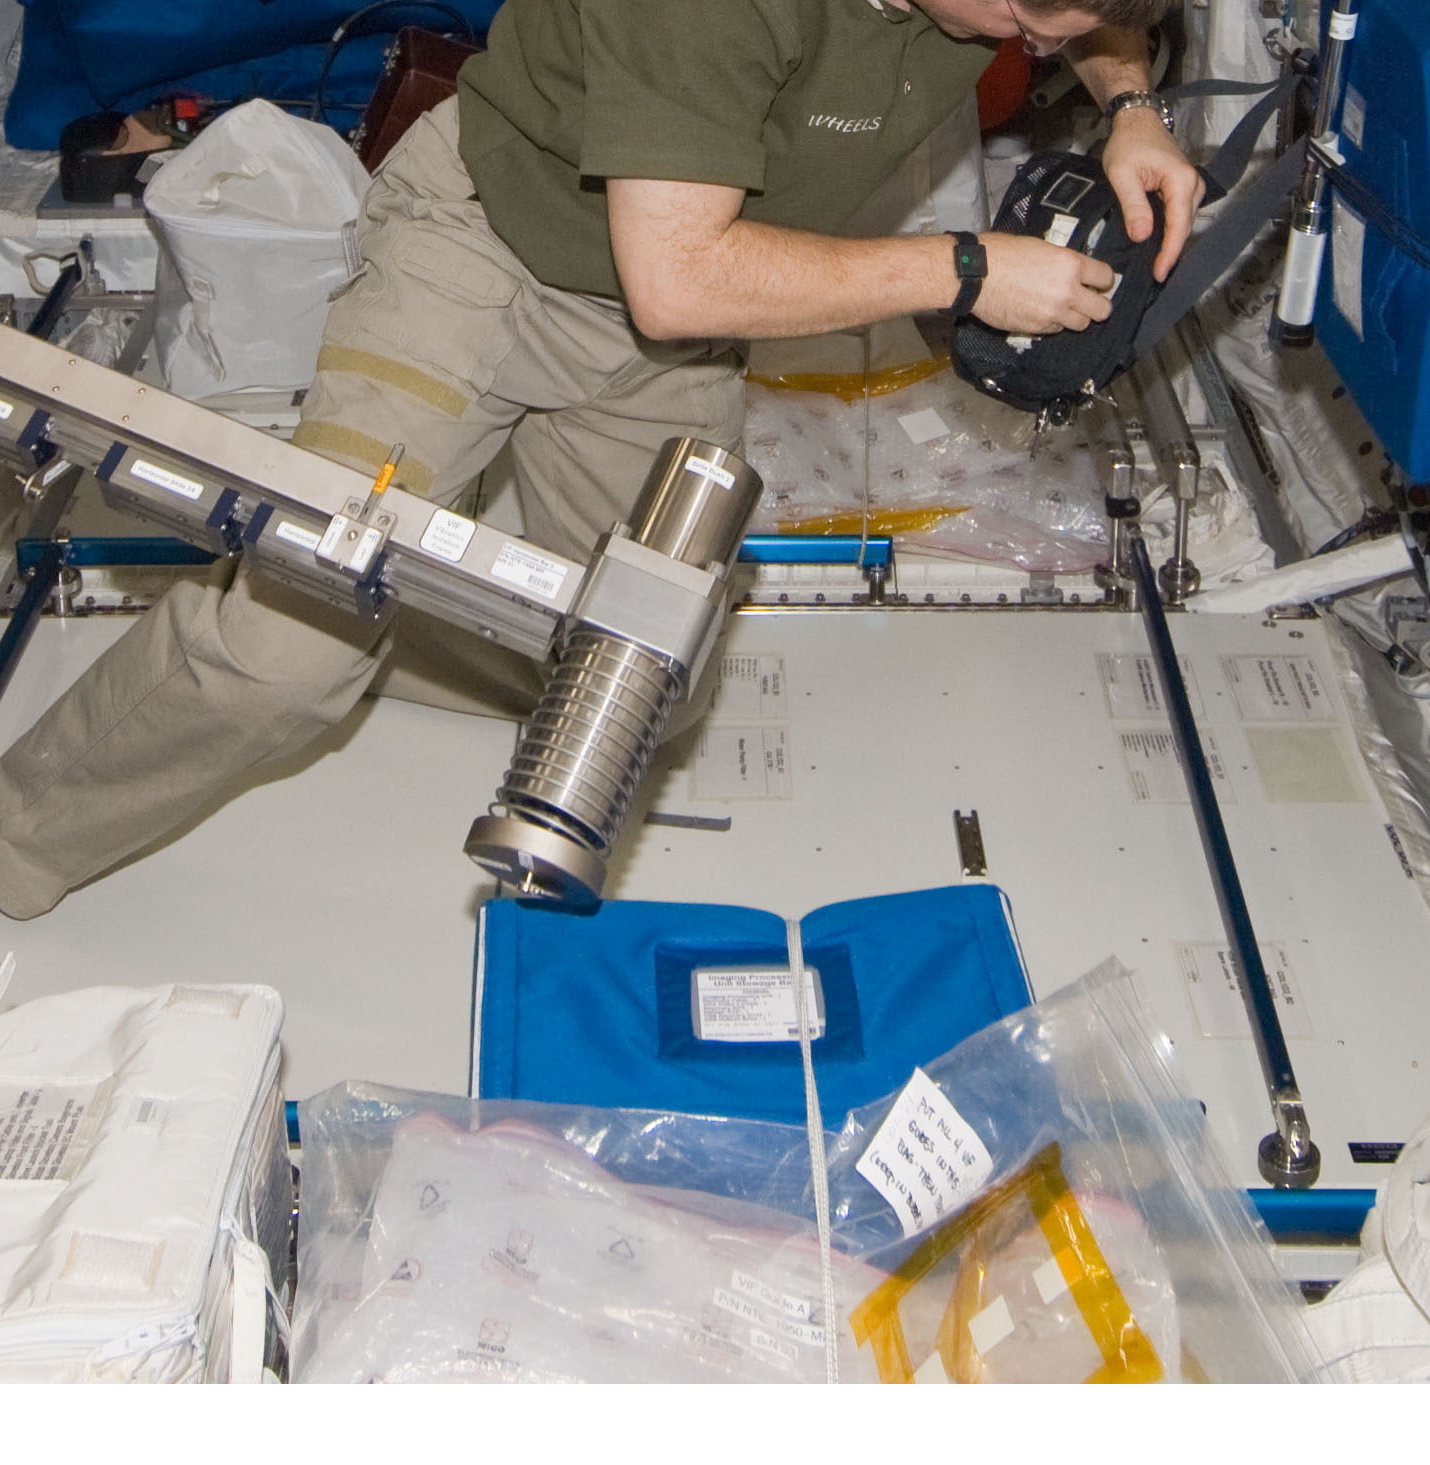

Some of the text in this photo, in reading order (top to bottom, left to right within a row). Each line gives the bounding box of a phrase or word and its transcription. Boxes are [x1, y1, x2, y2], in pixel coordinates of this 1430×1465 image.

[808, 114, 882, 133] WHEELS
[917, 1096, 936, 1121] PUT
[796, 1303, 806, 1314] A
